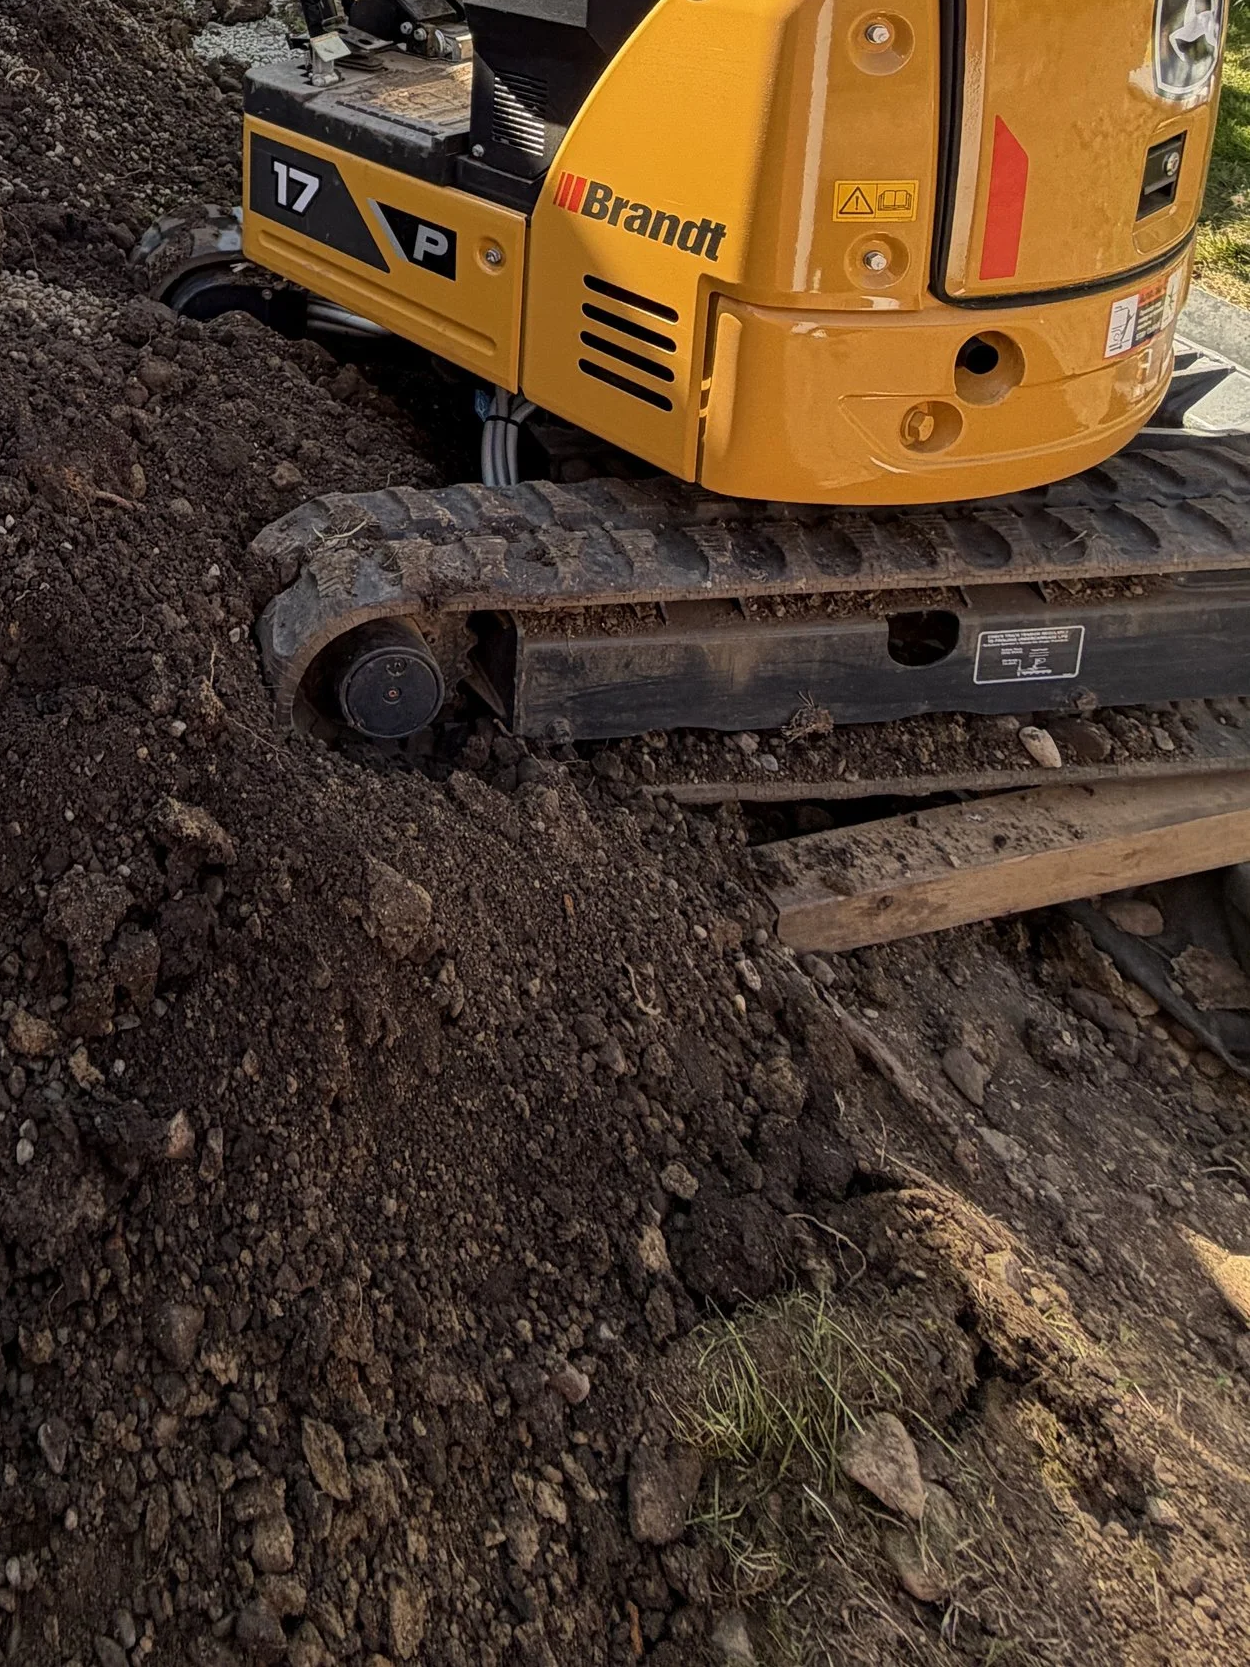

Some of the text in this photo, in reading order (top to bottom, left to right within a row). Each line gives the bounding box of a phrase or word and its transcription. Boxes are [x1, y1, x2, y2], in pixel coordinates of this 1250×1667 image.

[273, 160, 449, 261] 17 P
[581, 180, 727, 262] Brandt
